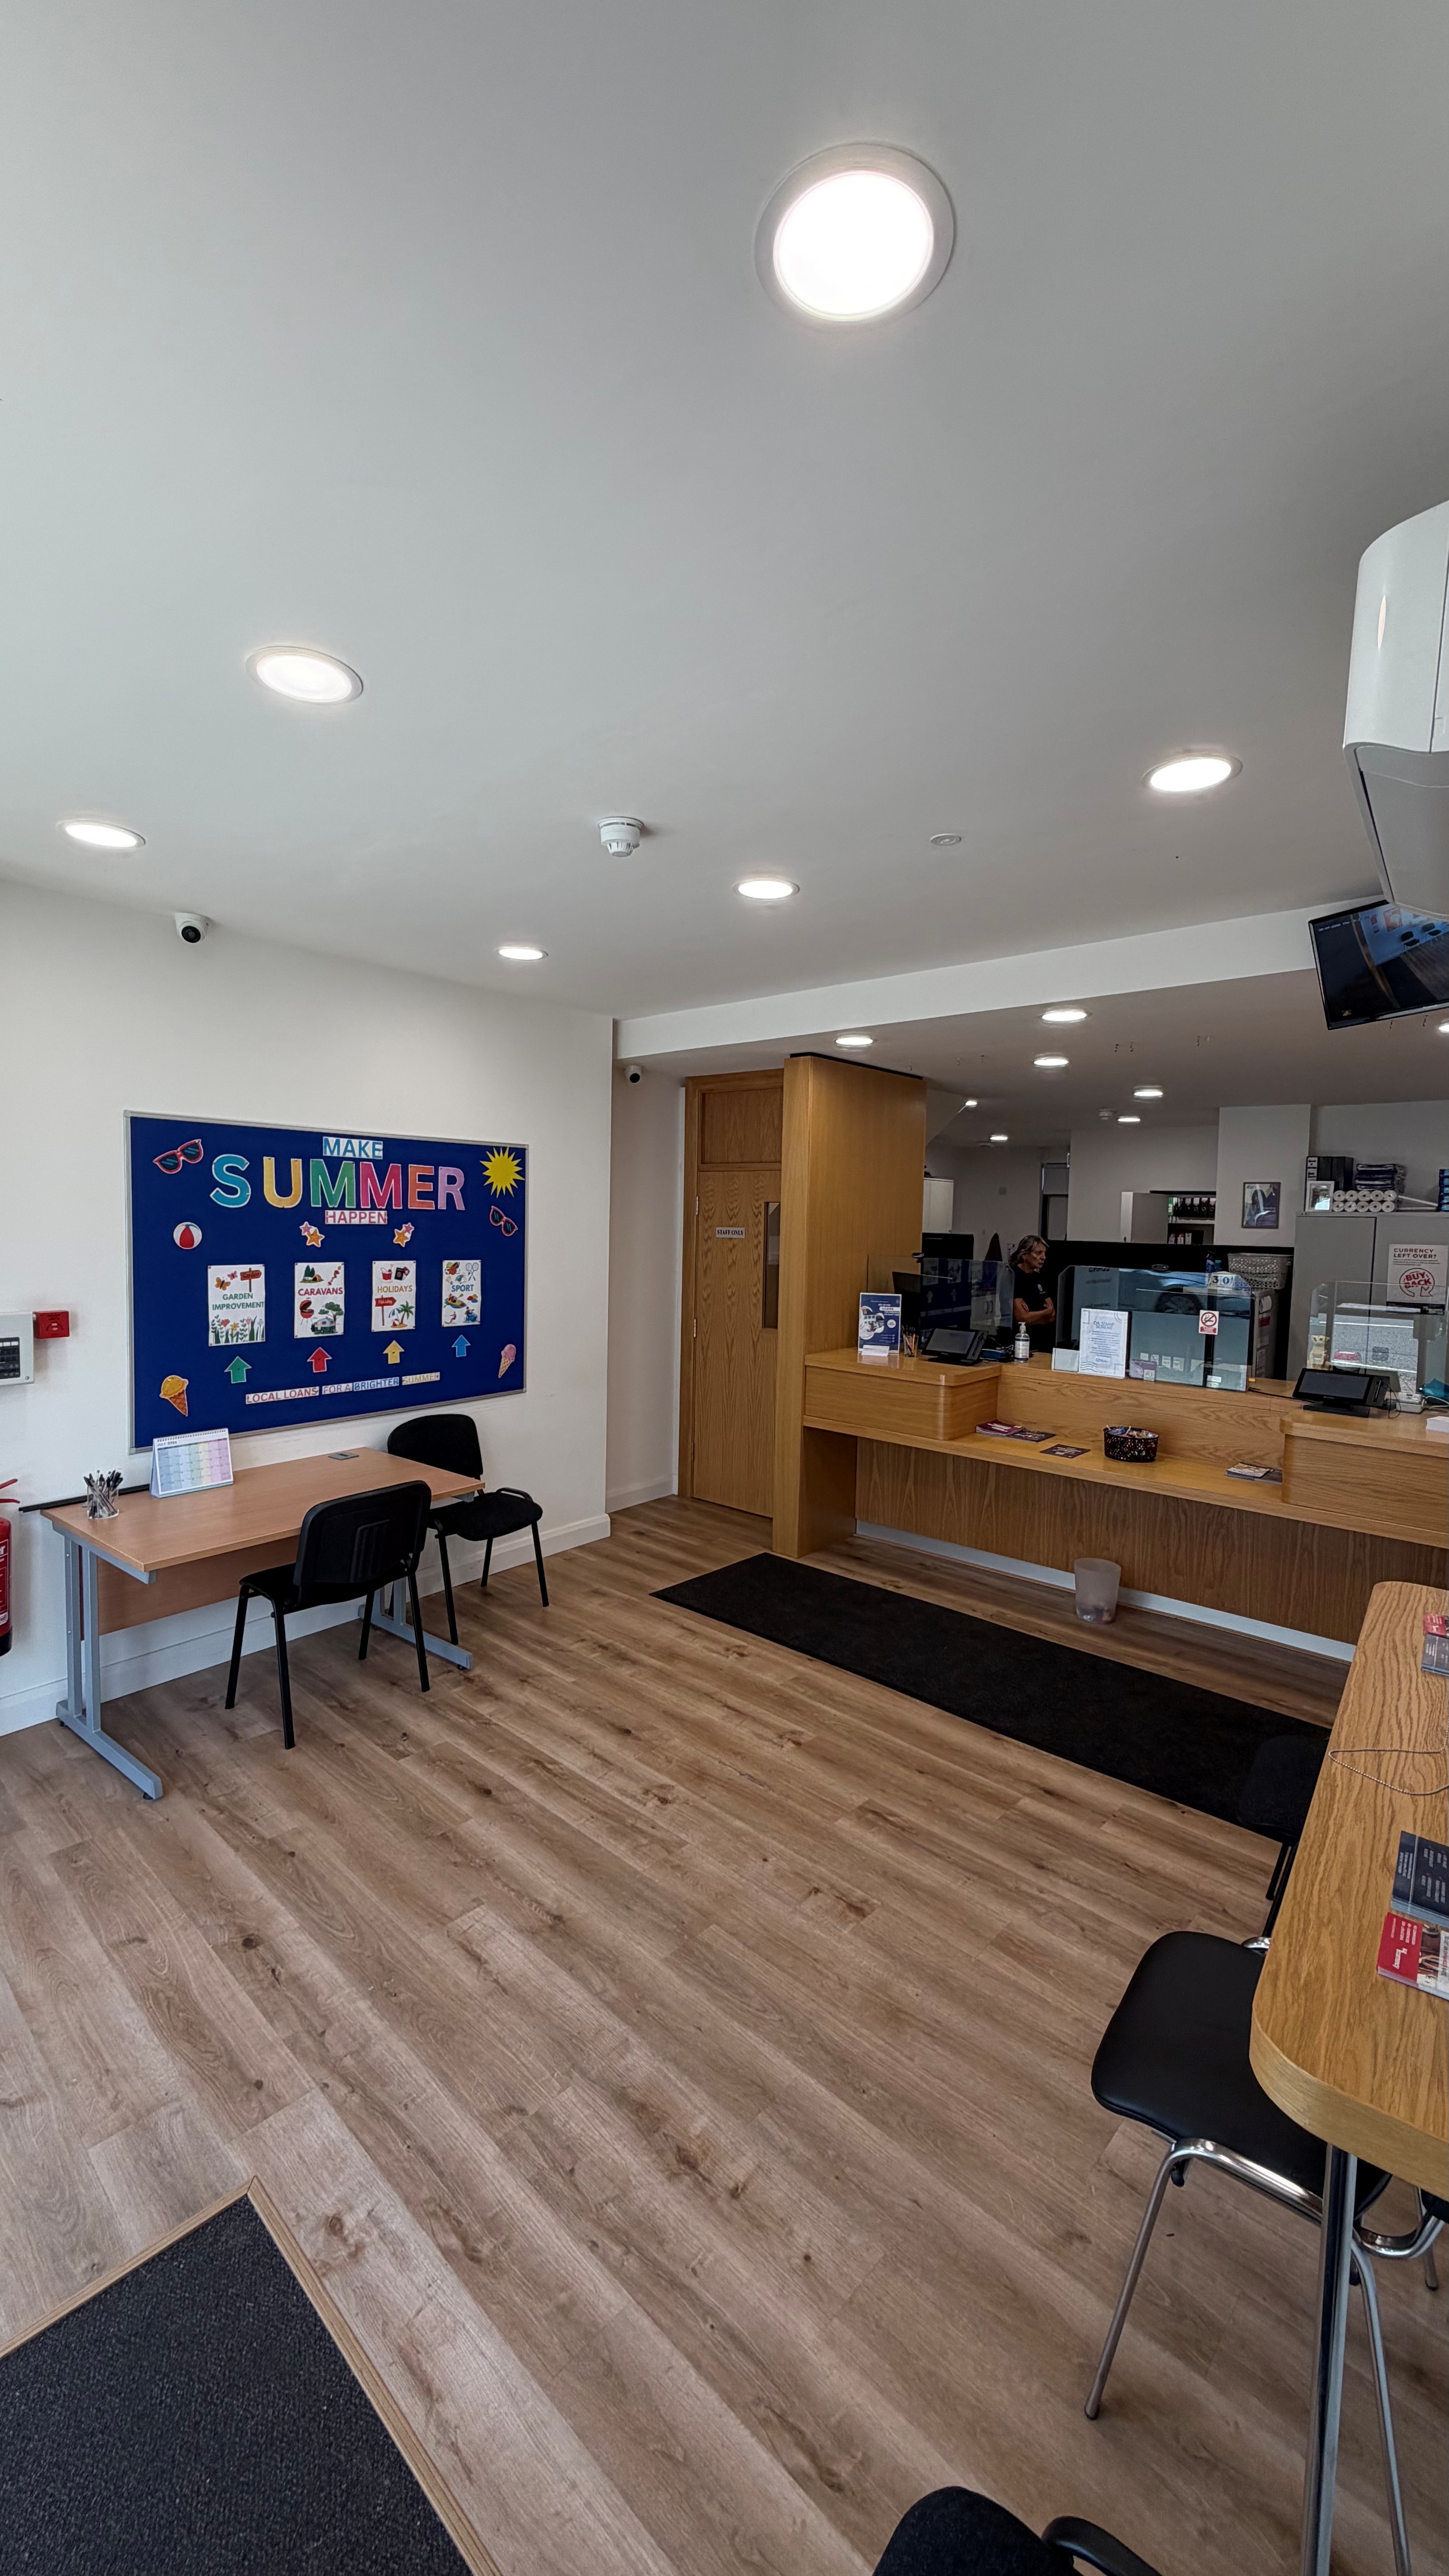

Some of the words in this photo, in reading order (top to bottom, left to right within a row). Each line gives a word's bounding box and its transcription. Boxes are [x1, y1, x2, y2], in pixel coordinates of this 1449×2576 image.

[323, 1137, 382, 1159] MAKE
[210, 1154, 465, 1210] SUMMER
[326, 1211, 387, 1224] HAPPEN
[1405, 1272, 1426, 1281] BUY
[1403, 1278, 1432, 1288] BACK
[298, 1287, 343, 1296] CARAVANS
[377, 1285, 413, 1293] HOLIDAYS
[222, 1293, 253, 1301] GARDEN
[212, 1302, 264, 1311] IMPROVEMENT
[247, 1392, 281, 1403] LOCAL
[284, 1387, 319, 1398] LOANS
[323, 1385, 342, 1394] FOR
[354, 1378, 399, 1391] BRIGHTER
[403, 1372, 439, 1385] SUMMER
